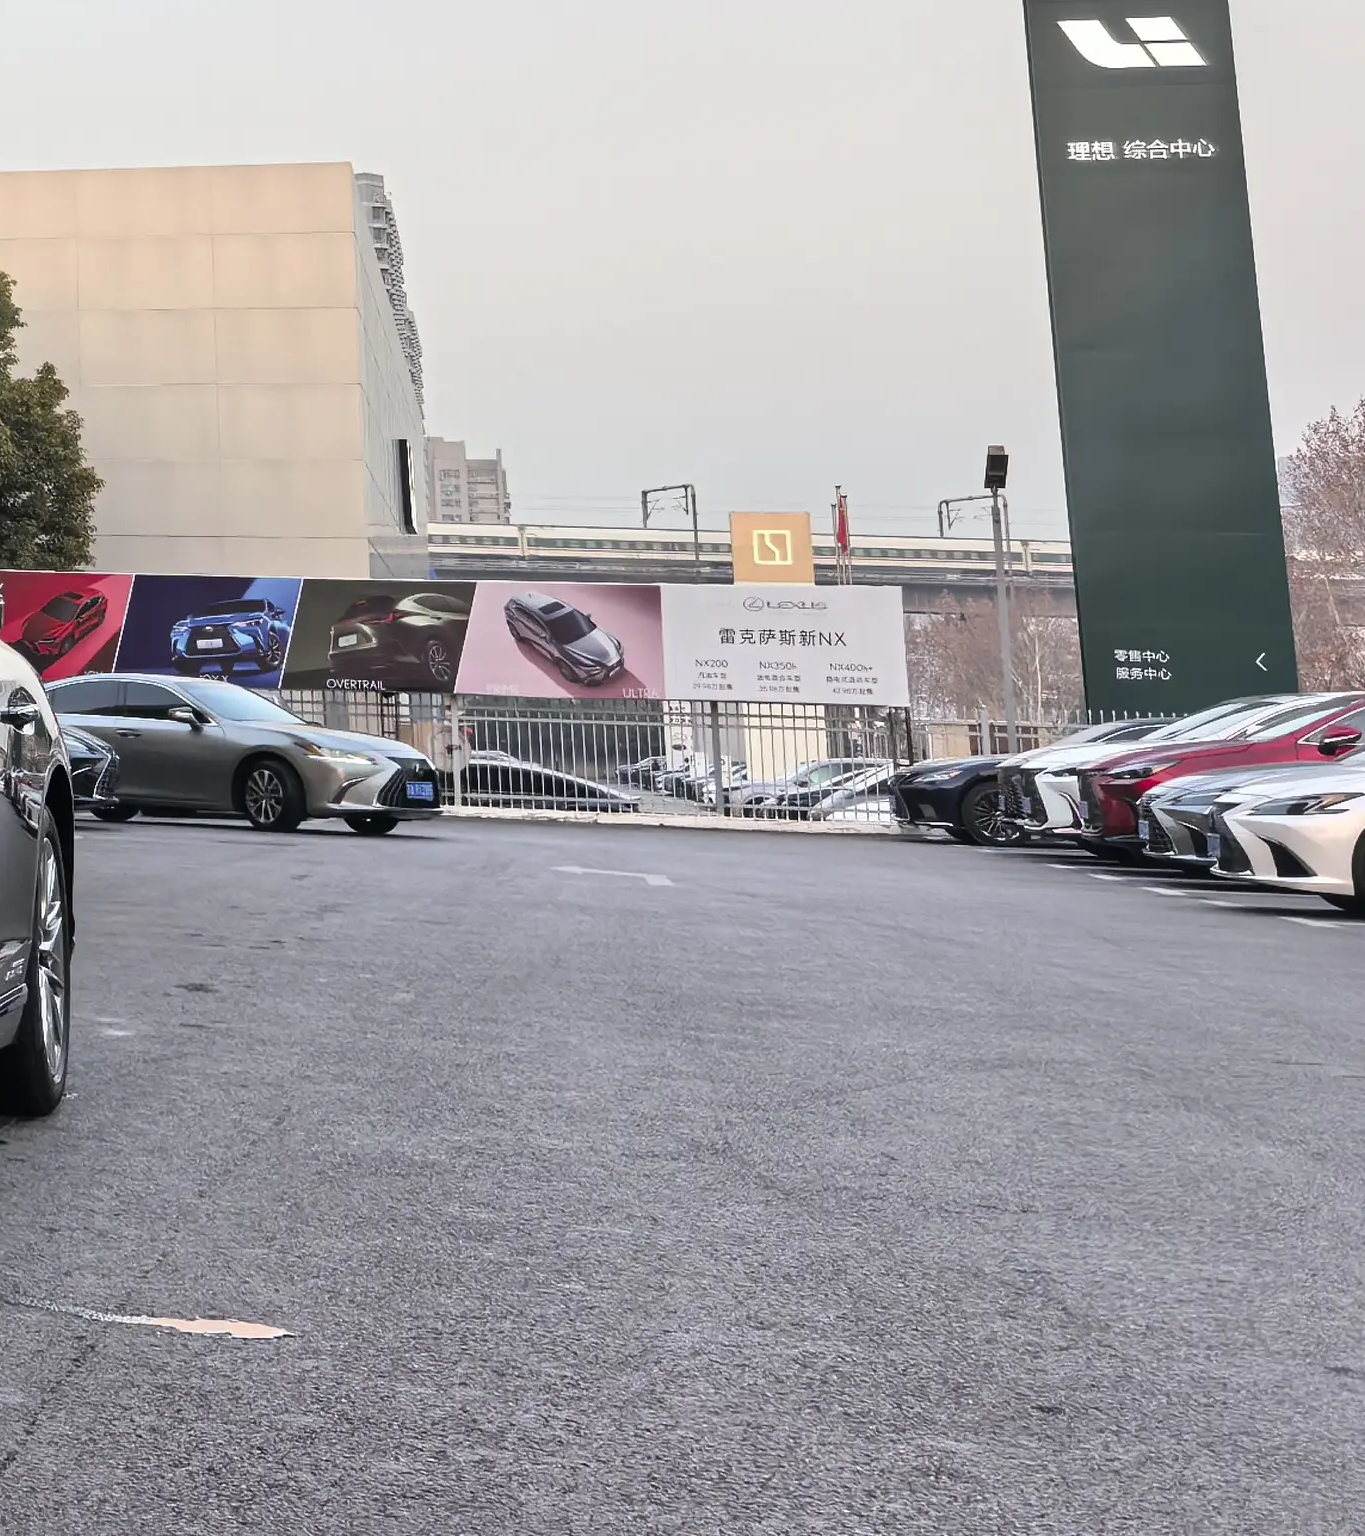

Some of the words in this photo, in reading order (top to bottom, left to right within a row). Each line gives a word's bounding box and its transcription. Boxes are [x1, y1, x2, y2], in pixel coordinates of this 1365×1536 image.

[1067, 140, 1115, 161] 理想
[1123, 138, 1216, 160] 综合中心
[766, 600, 828, 610] LEXUS
[719, 627, 847, 647] 雷克萨斯新NX
[1114, 649, 1170, 663] 零售中心
[695, 659, 729, 668] NX200
[1116, 666, 1172, 680] 服务中心
[326, 678, 386, 691] OVERTRAIL
[623, 688, 659, 699] ULTRA
